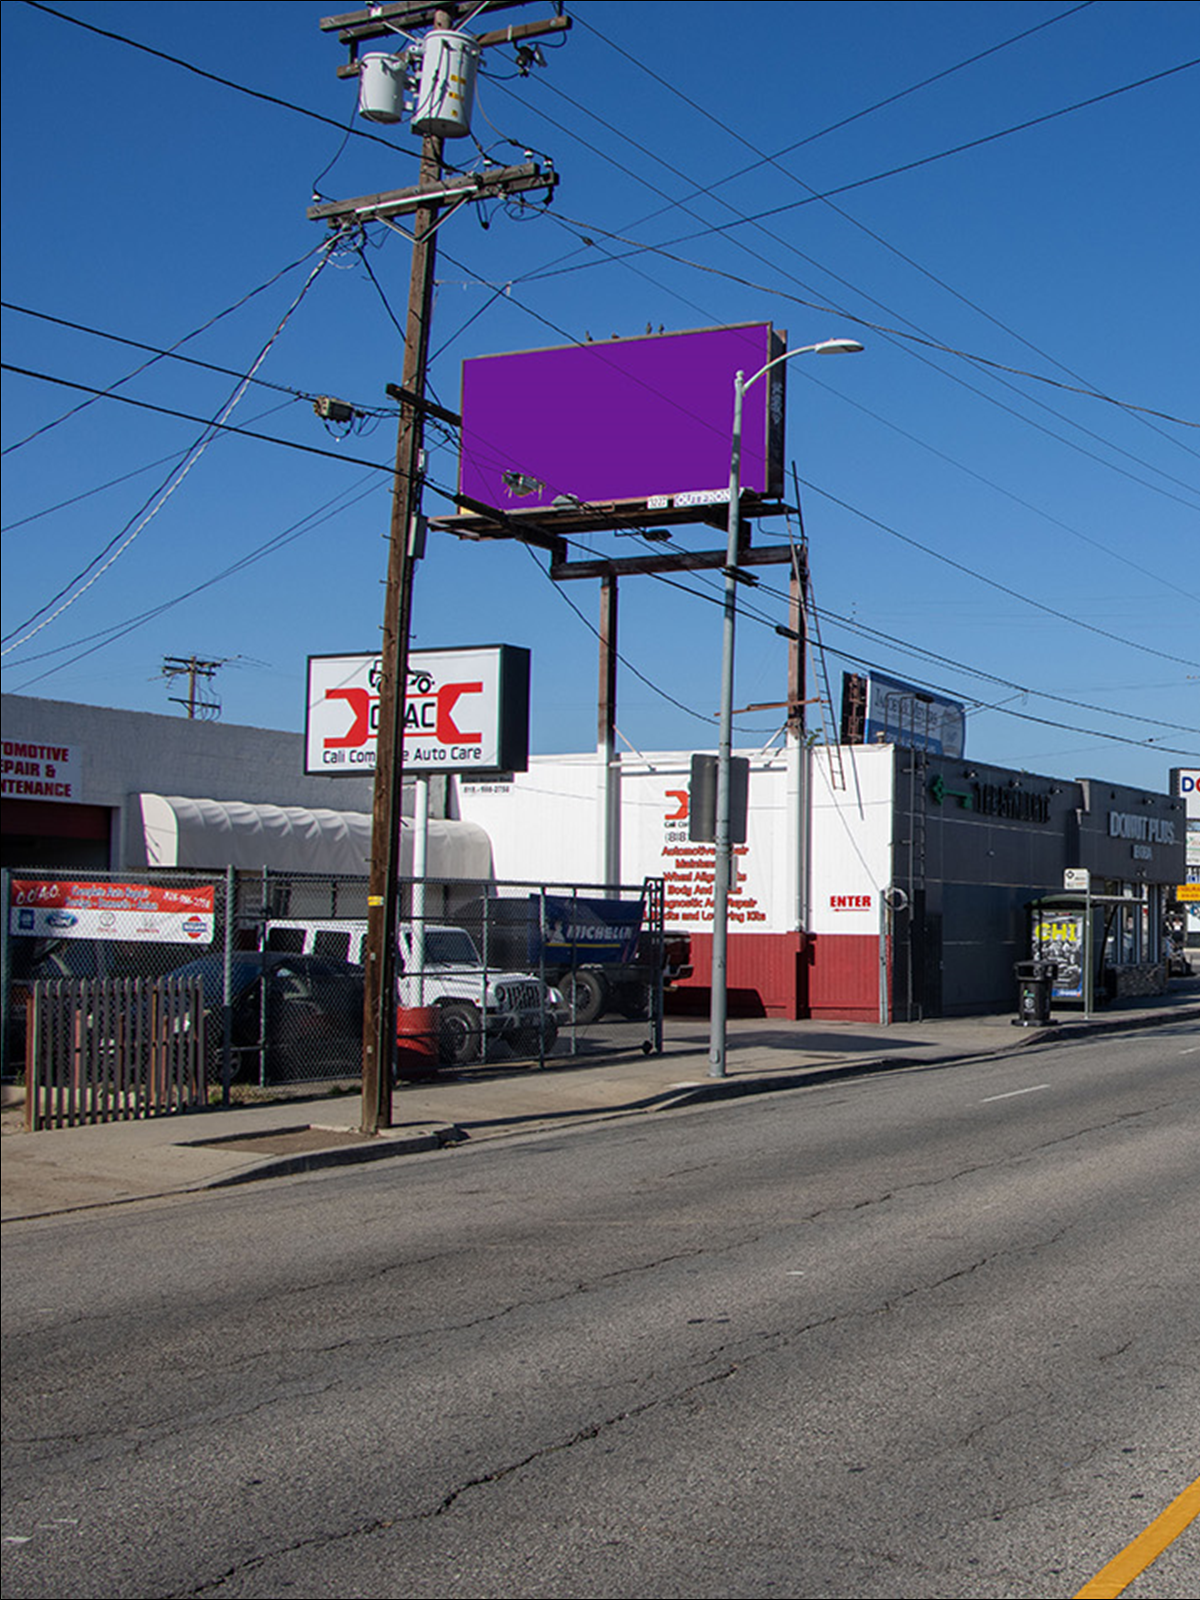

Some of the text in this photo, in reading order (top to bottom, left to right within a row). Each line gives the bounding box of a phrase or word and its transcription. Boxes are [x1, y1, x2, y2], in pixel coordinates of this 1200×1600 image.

[675, 489, 732, 506] OUTFRON
[370, 702, 435, 729] CAC
[323, 750, 345, 764] Cali
[414, 748, 446, 761] Auto
[451, 747, 482, 760] Care
[1, 760, 57, 778] PAIR &
[1109, 811, 1147, 840] DONUT
[1148, 818, 1175, 844] PLUS
[675, 859, 715, 869] Mainten
[663, 872, 692, 882] Wheel
[668, 885, 692, 896] Body
[830, 895, 872, 907] ENTER
[682, 911, 699, 921] and
[1035, 923, 1077, 942] CHI
